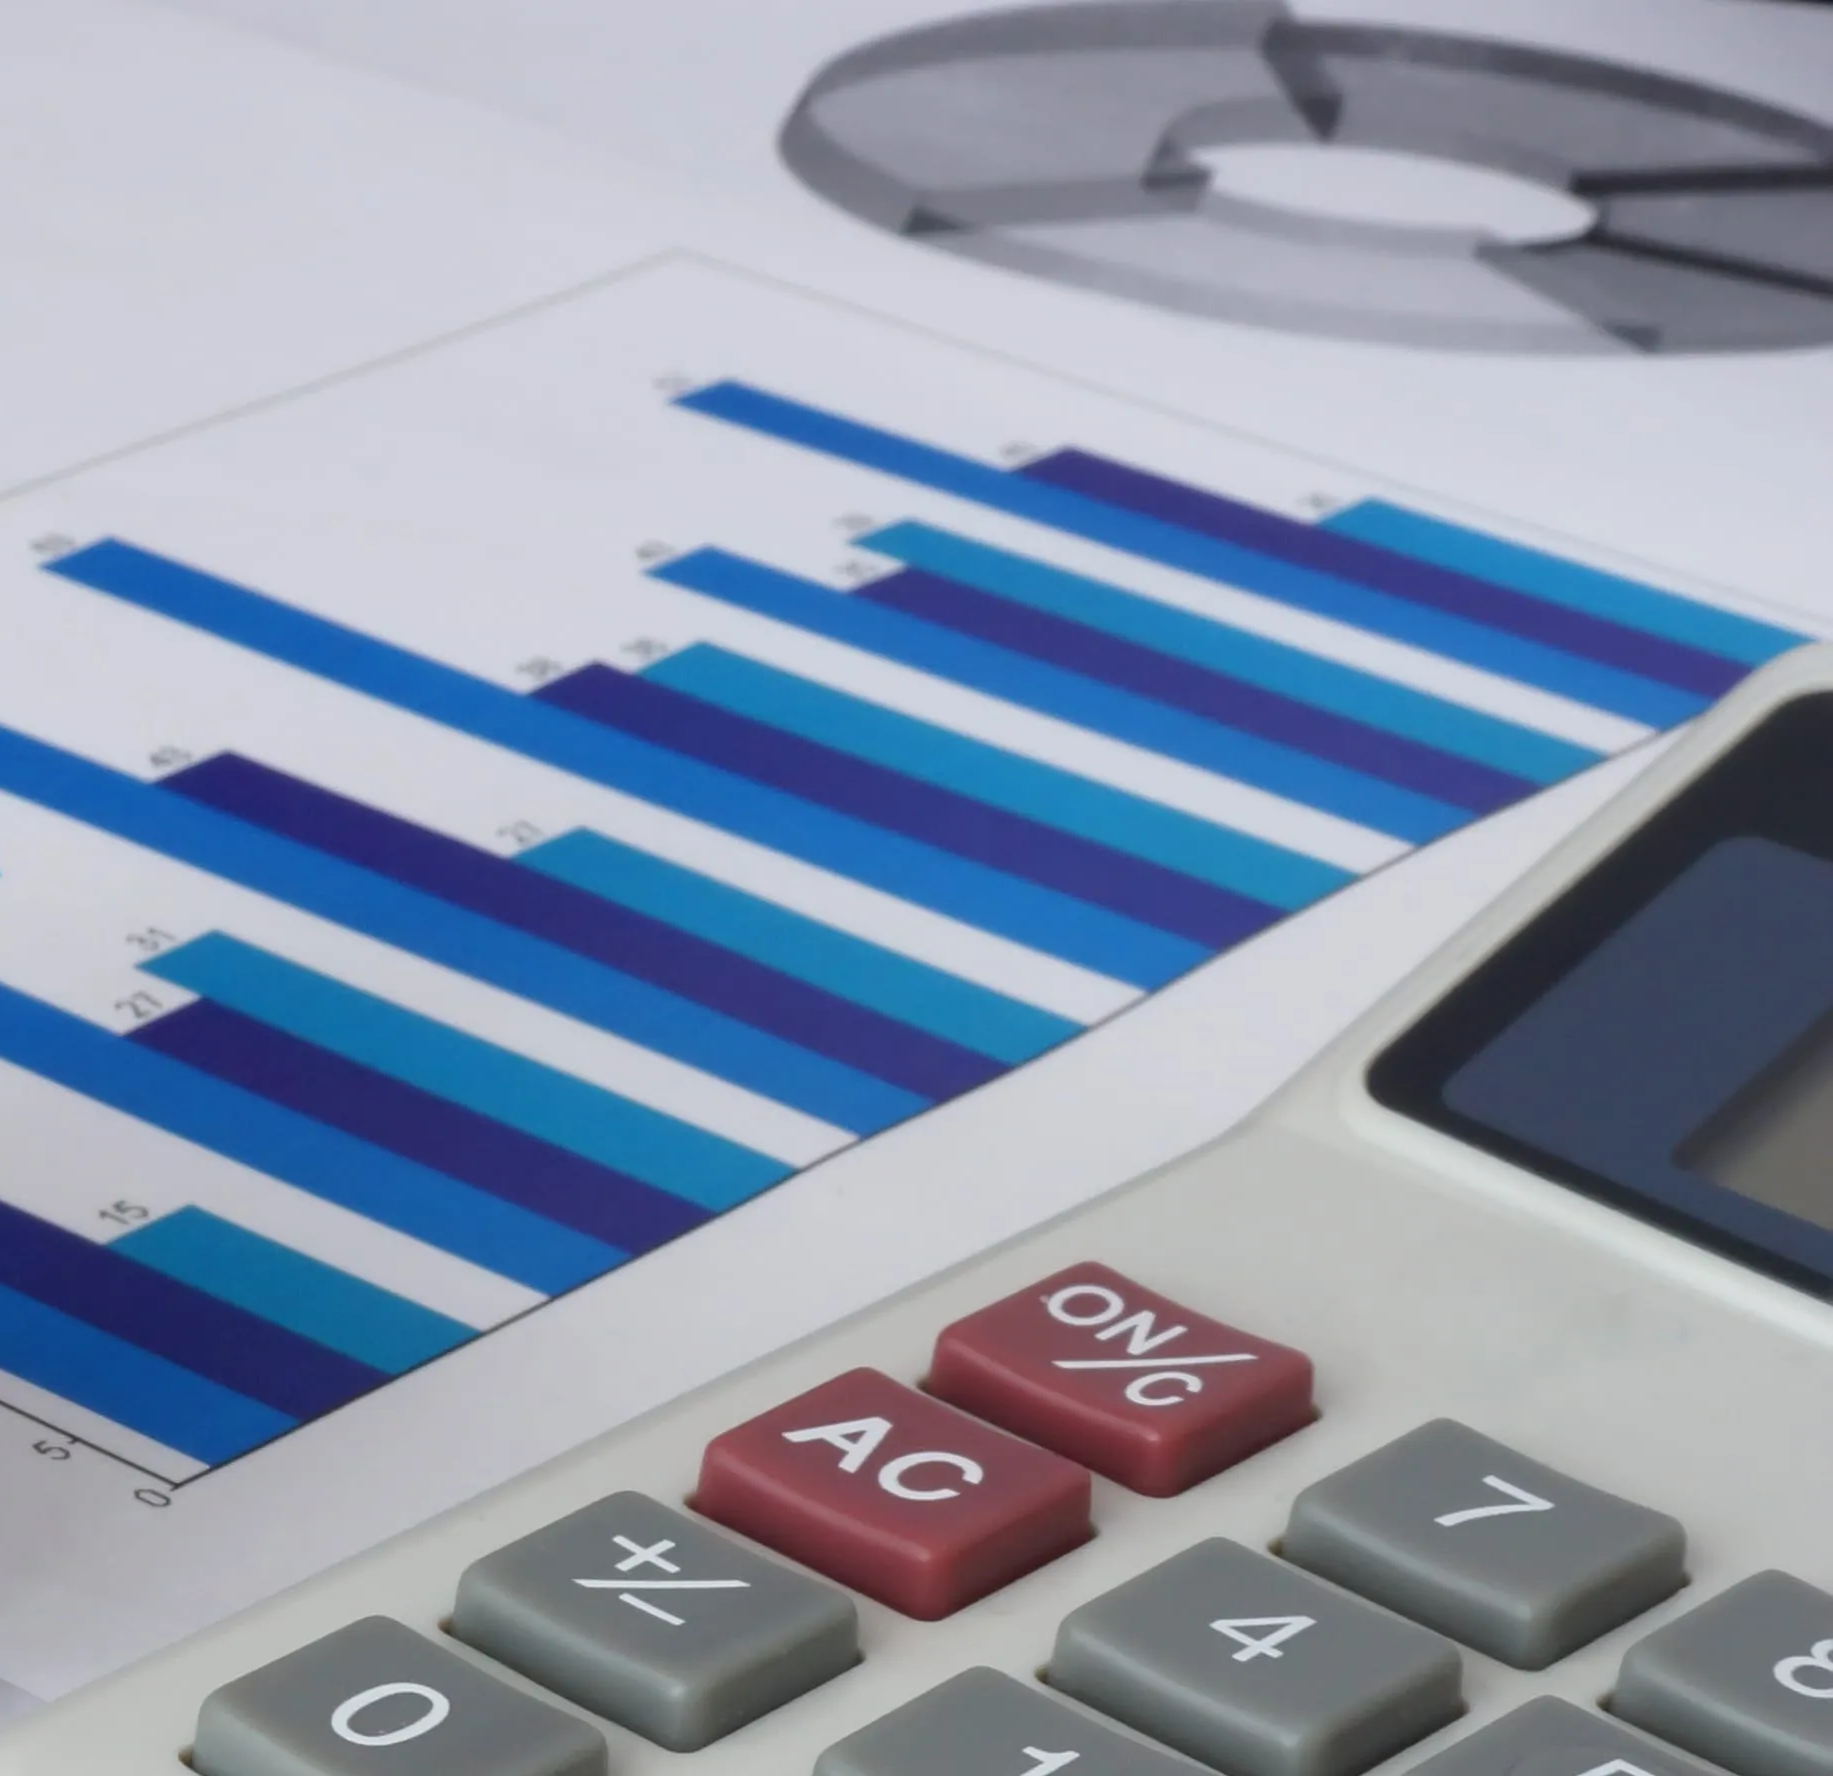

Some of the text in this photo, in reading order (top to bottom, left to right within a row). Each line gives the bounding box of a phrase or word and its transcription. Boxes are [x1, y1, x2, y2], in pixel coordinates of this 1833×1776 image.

[98, 1200, 150, 1225] 15
[32, 1438, 72, 1462] 5
[780, 1416, 985, 1503] AC
[133, 1487, 173, 1509] 0
[1433, 1474, 1556, 1528] 7
[1209, 1615, 1318, 1664] 4
[332, 1681, 450, 1747] 0
